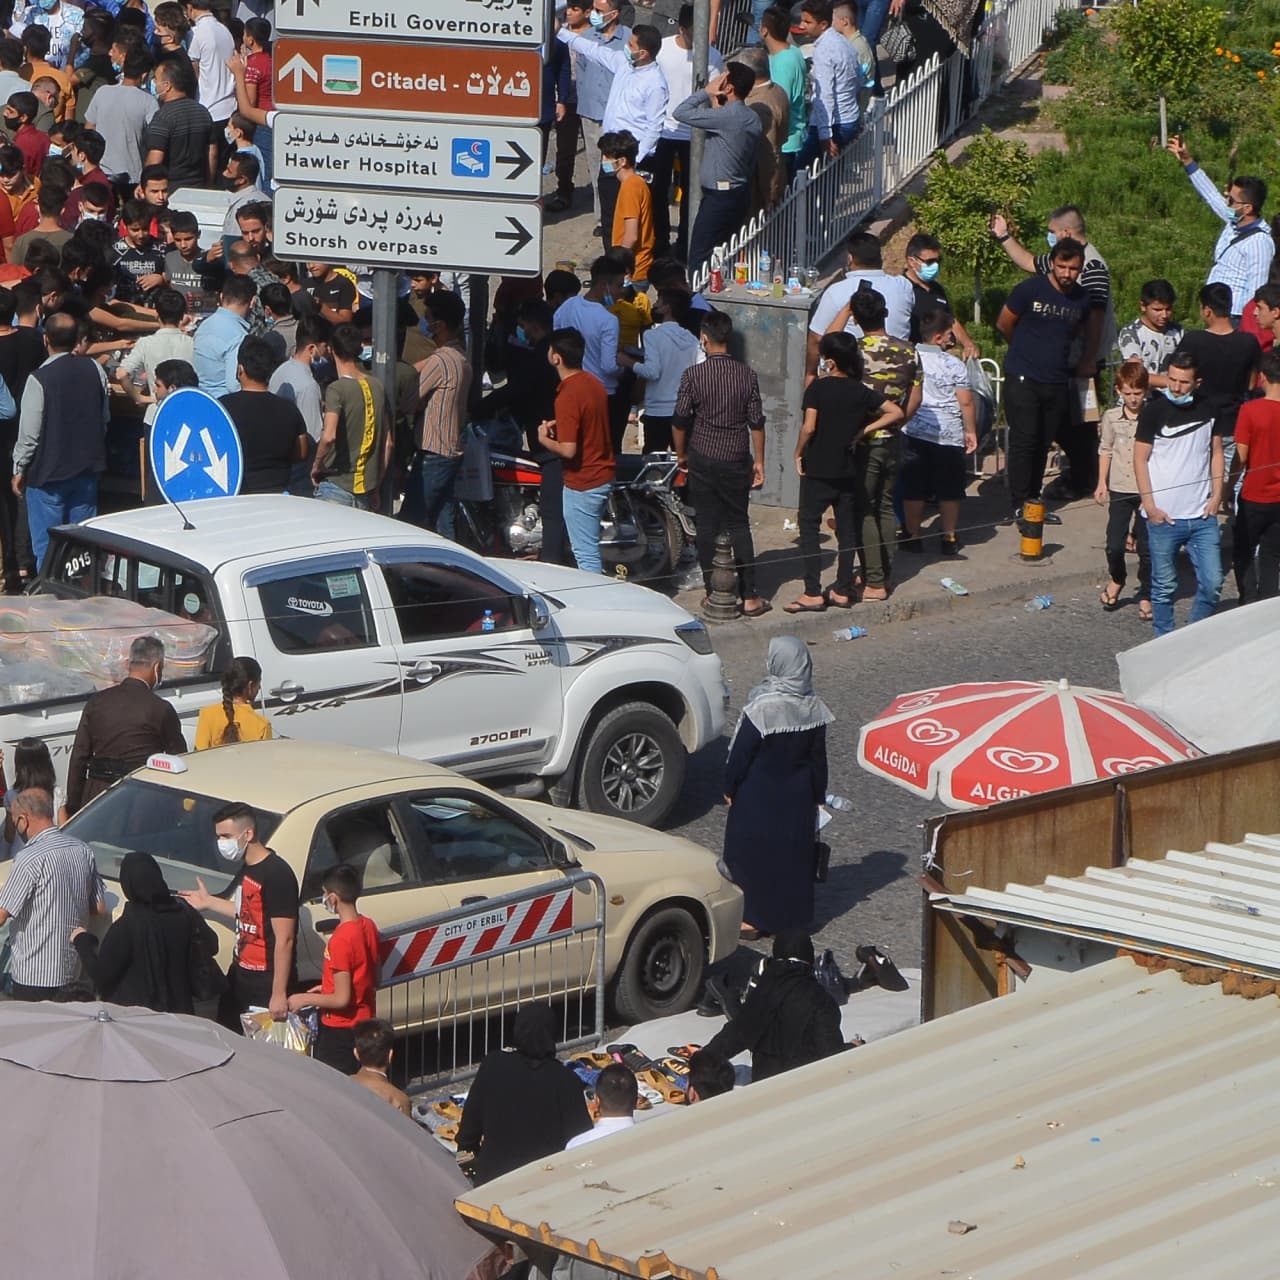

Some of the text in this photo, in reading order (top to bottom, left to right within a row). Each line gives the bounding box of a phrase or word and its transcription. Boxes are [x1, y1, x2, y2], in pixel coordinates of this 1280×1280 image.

[349, 10, 534, 37] Erbil Governorate
[370, 70, 448, 92] Citadel
[465, 66, 532, 98] قەڵات
[284, 126, 440, 153] نەخۆشخانەی هەولێر
[284, 152, 438, 177] Hawler Hospital
[284, 197, 444, 235] بەرزە پردی شۆرش
[284, 231, 439, 256] Shorsh overpass
[65, 551, 91, 577] 2015
[298, 598, 325, 610] TOYOTA
[469, 727, 532, 746] 2700 EFI
[444, 913, 504, 937] CITY OF ERBIL
